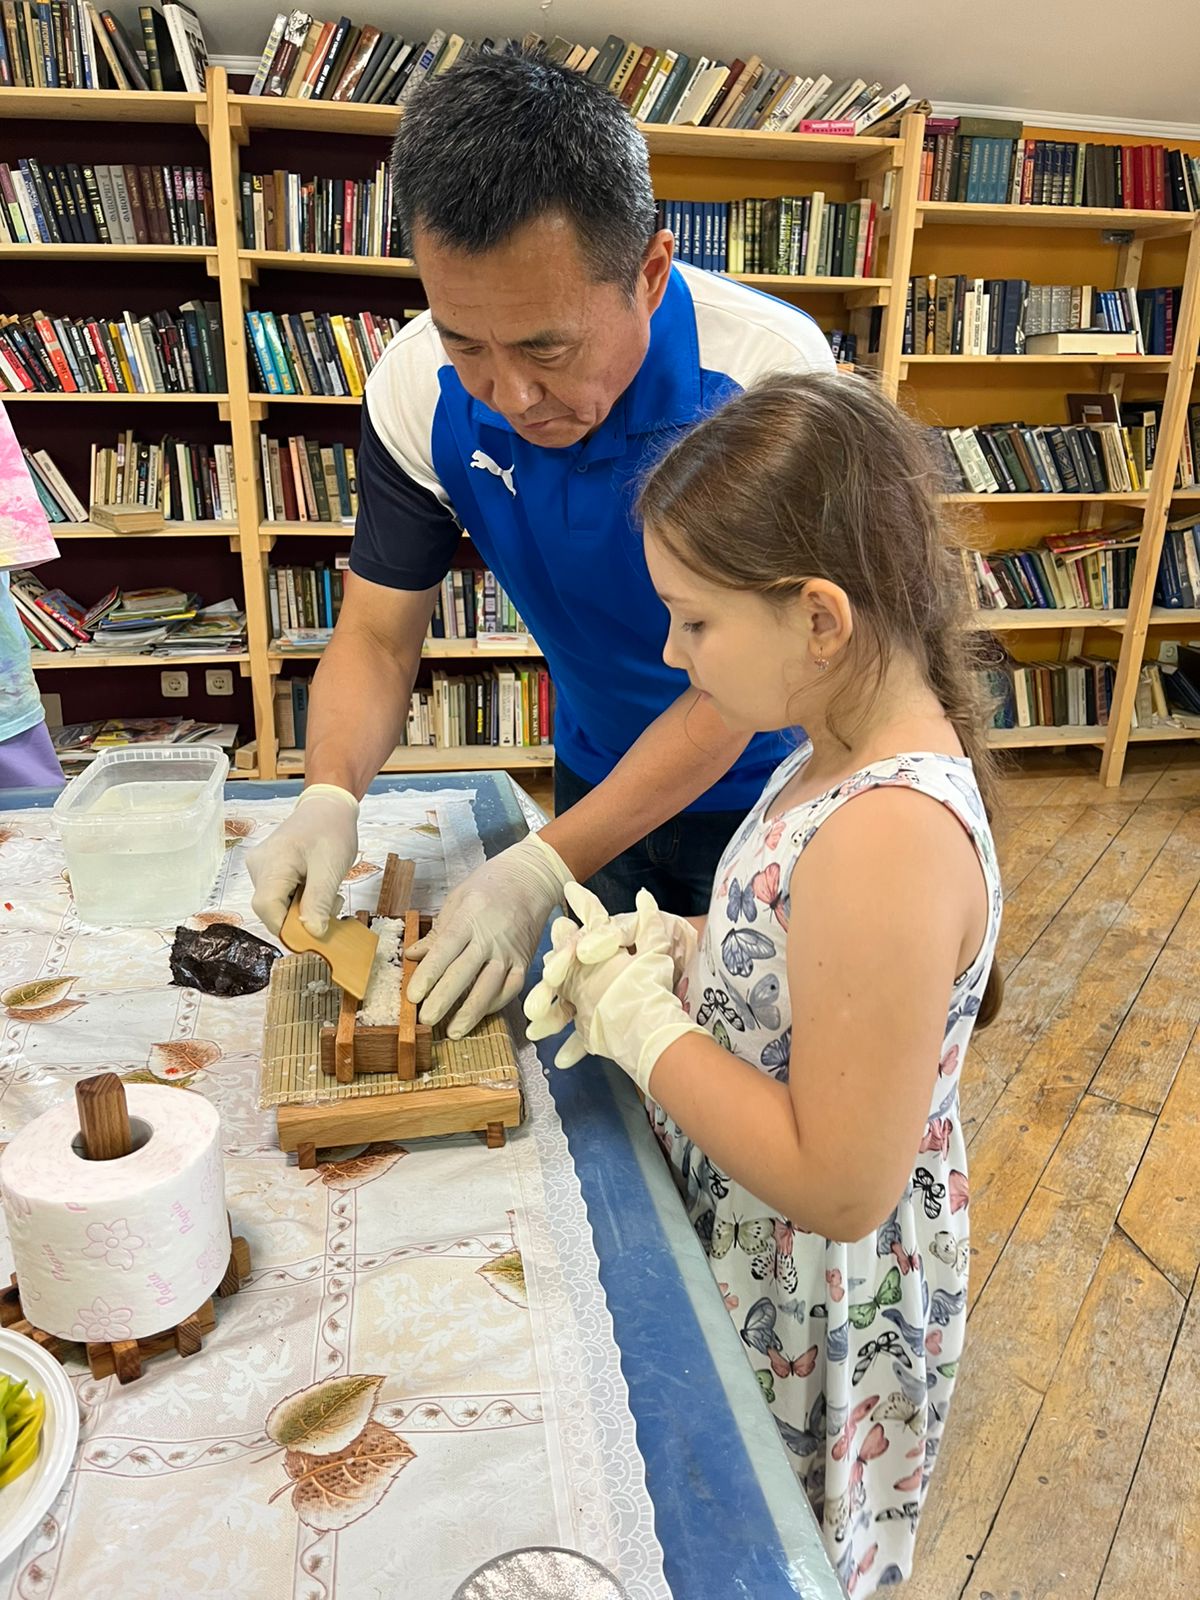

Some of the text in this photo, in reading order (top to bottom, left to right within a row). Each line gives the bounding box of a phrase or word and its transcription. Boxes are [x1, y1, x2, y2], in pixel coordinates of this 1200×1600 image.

[41, 21, 52, 56] АУТСОРСИНГ
[103, 183, 117, 222] ФАВОРИТ
[117, 182, 130, 222] ФАВОРИТ
[101, 356, 113, 384] АРКАНОВ
[111, 357, 123, 384] АРКАНОВ
[172, 1201, 195, 1235] Papia
[42, 1244, 71, 1282] Papia
[148, 1272, 178, 1307] Papia
